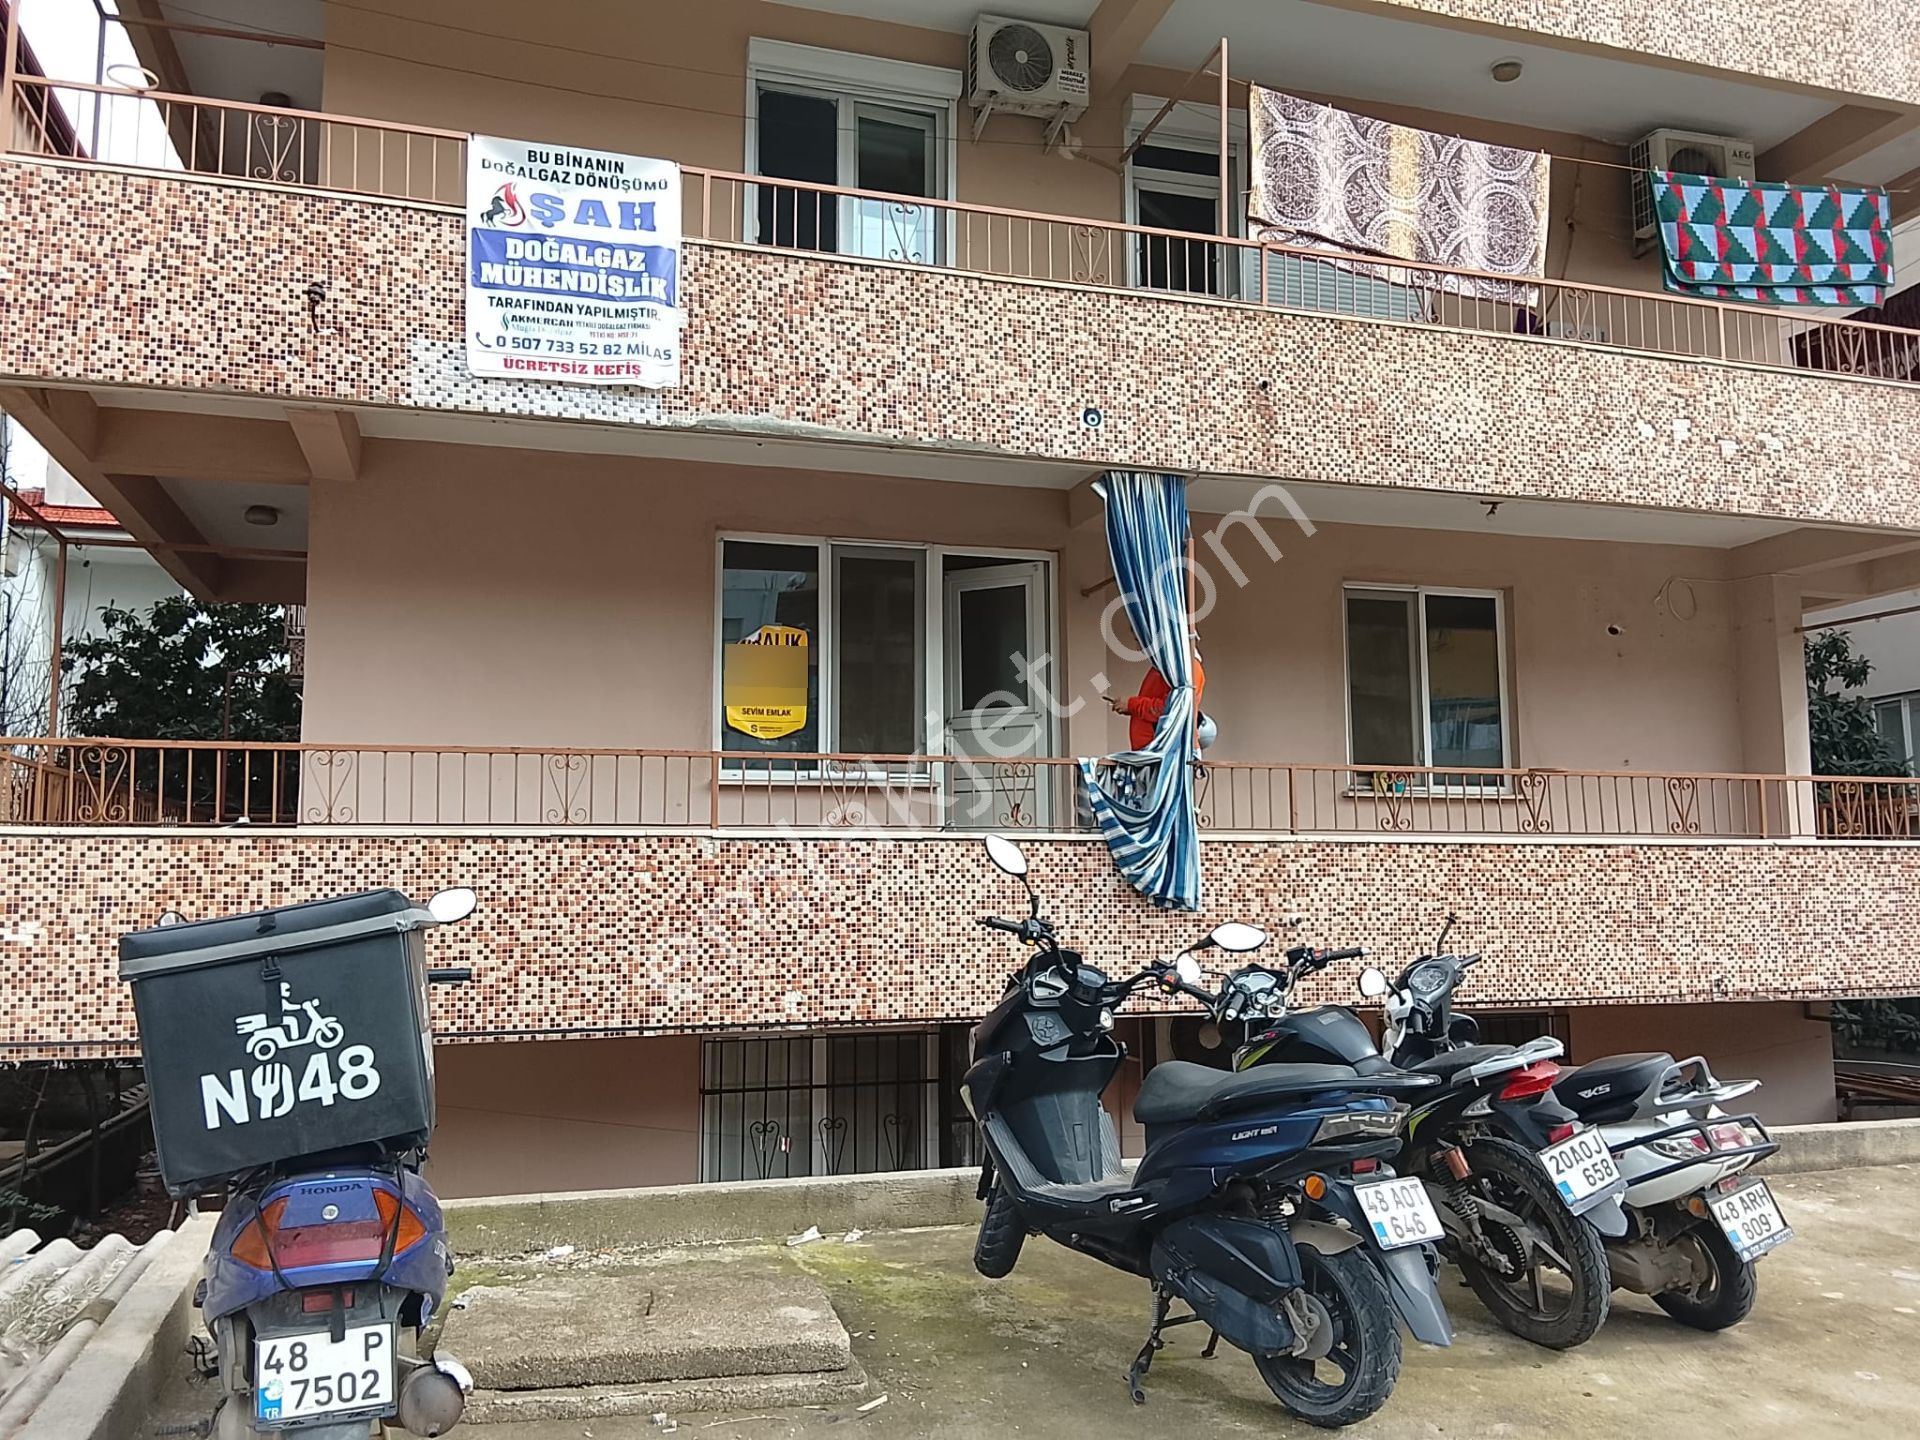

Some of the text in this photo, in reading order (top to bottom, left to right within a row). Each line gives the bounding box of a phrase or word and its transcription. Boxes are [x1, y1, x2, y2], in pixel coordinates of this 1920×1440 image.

[528, 150, 624, 174] BU BİNANIN
[1732, 150, 1751, 159] AEG
[482, 158, 668, 193] DOĞALGAZ DÖNÜŞÜMÜ
[530, 193, 656, 231] ŞAH
[506, 237, 646, 272] DOĞALGAZ
[480, 261, 667, 300] MÜHENDİSLİK
[487, 296, 661, 321] TARAFINDAN YAPILMIŞTIR.
[510, 314, 573, 328] AKMERCAN
[496, 335, 672, 360] 0 507 733 52 82 MİLAS
[503, 356, 641, 378] ÜCRETSİZ KEFİŞ
[742, 707, 791, 717] SEVİM EMLAK
[1582, 1159, 1614, 1187] 658
[300, 1183, 363, 1196] HONDA
[1365, 1190, 1389, 1214] 48
[1718, 1187, 1771, 1223] 48 ARH
[1390, 1212, 1427, 1239] 646
[1742, 1213, 1771, 1241] 809
[264, 1332, 383, 1374] 48 P
[264, 1369, 380, 1418] TR 7502
